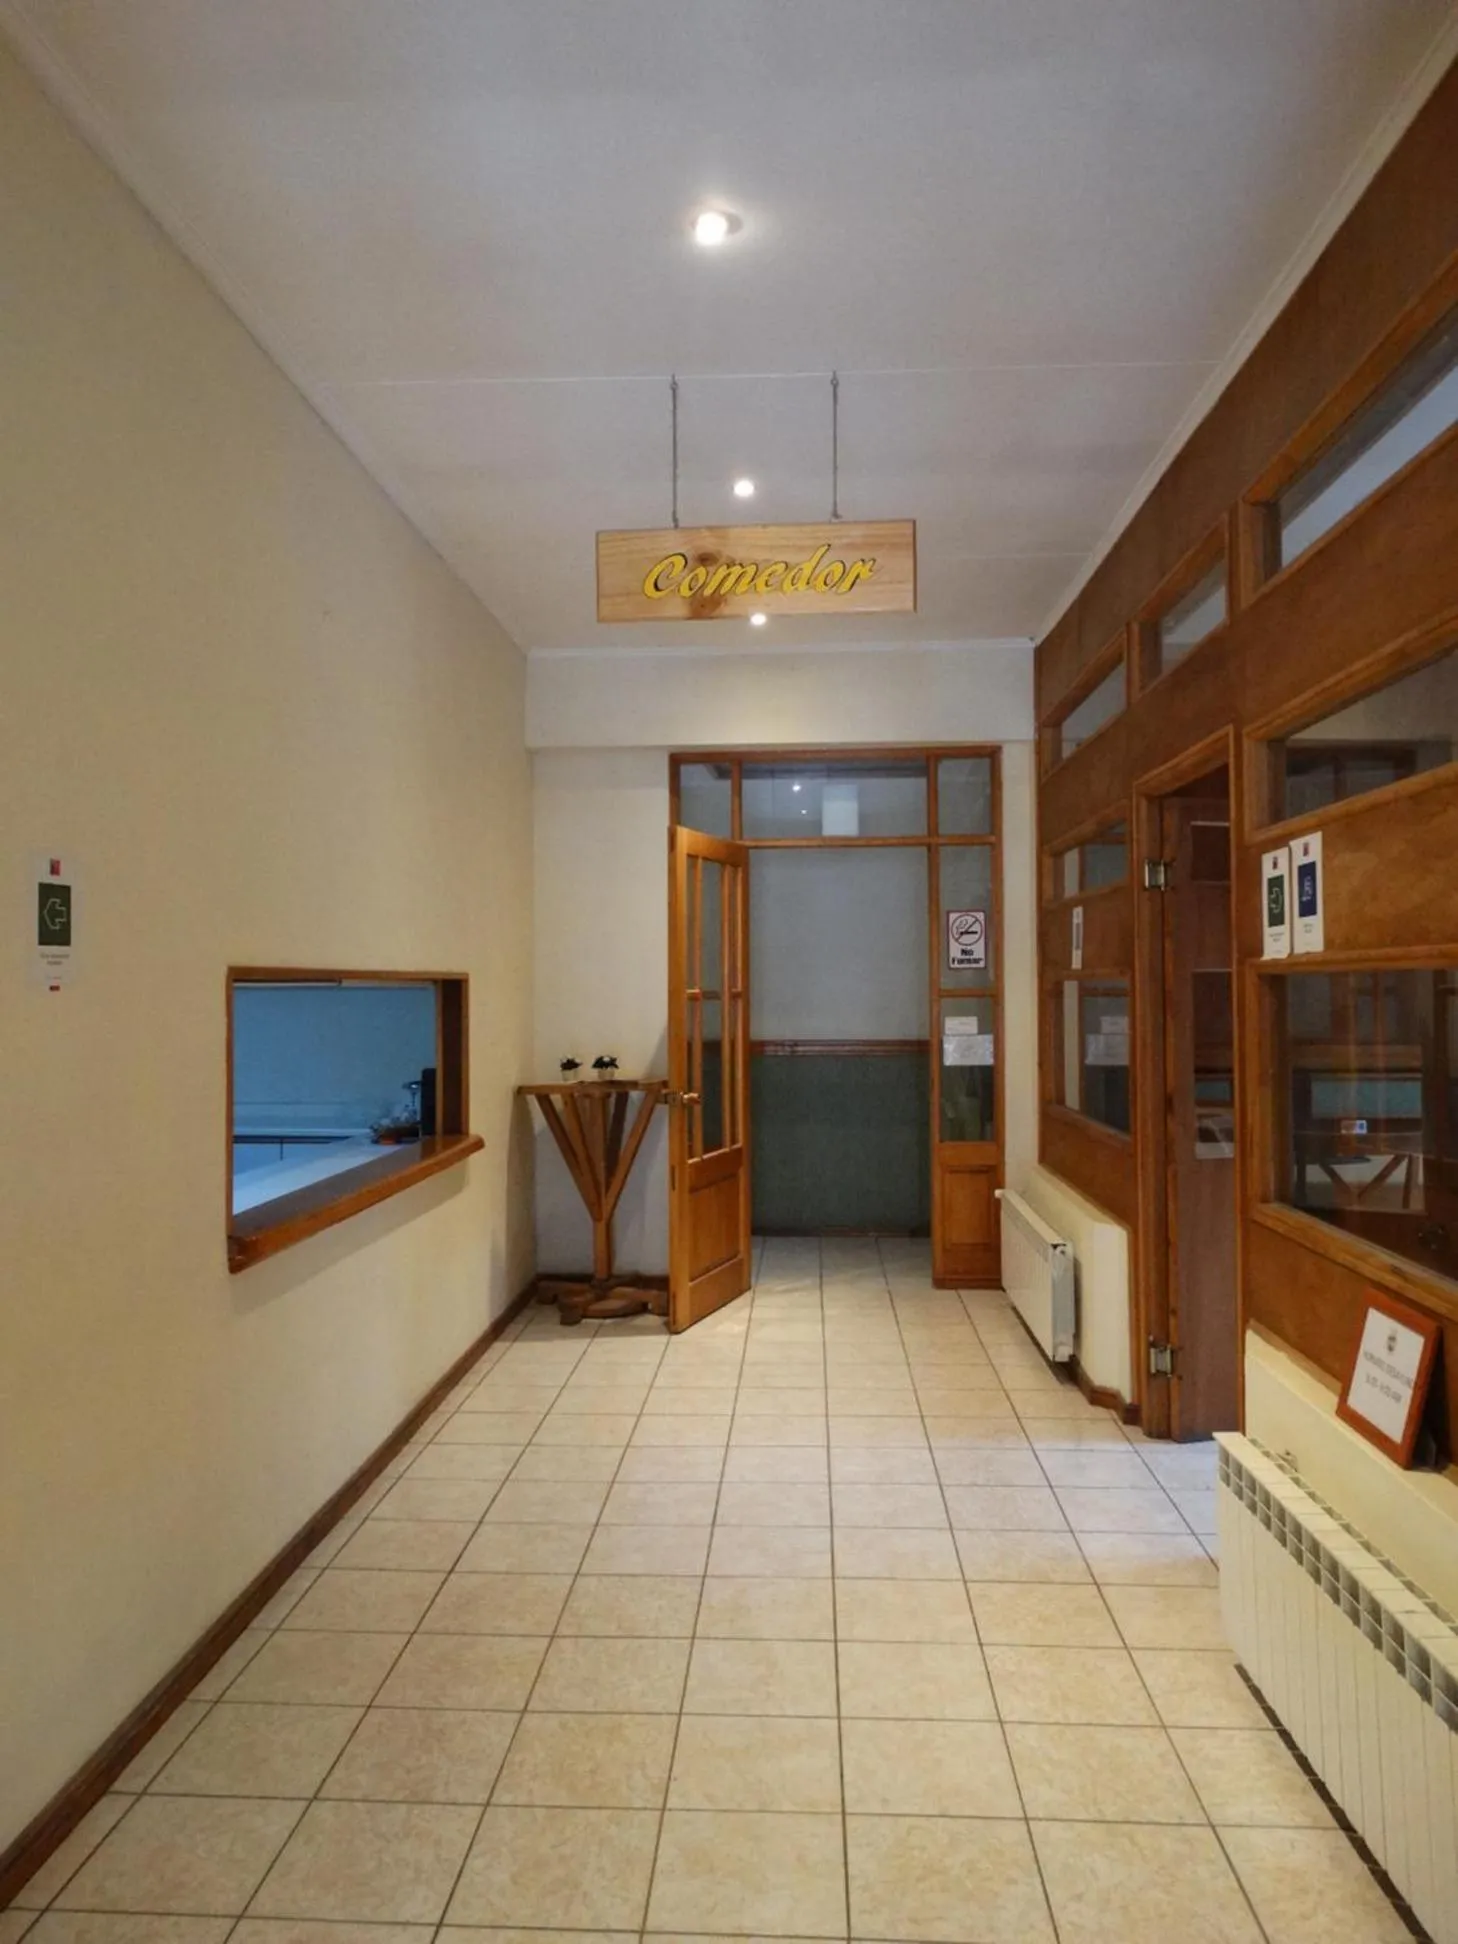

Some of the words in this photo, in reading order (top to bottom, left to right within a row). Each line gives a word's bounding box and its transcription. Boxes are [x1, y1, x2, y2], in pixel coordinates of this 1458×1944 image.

[642, 543, 877, 600] Comedor
[960, 948, 974, 956] No
[951, 957, 983, 965] Fumar
